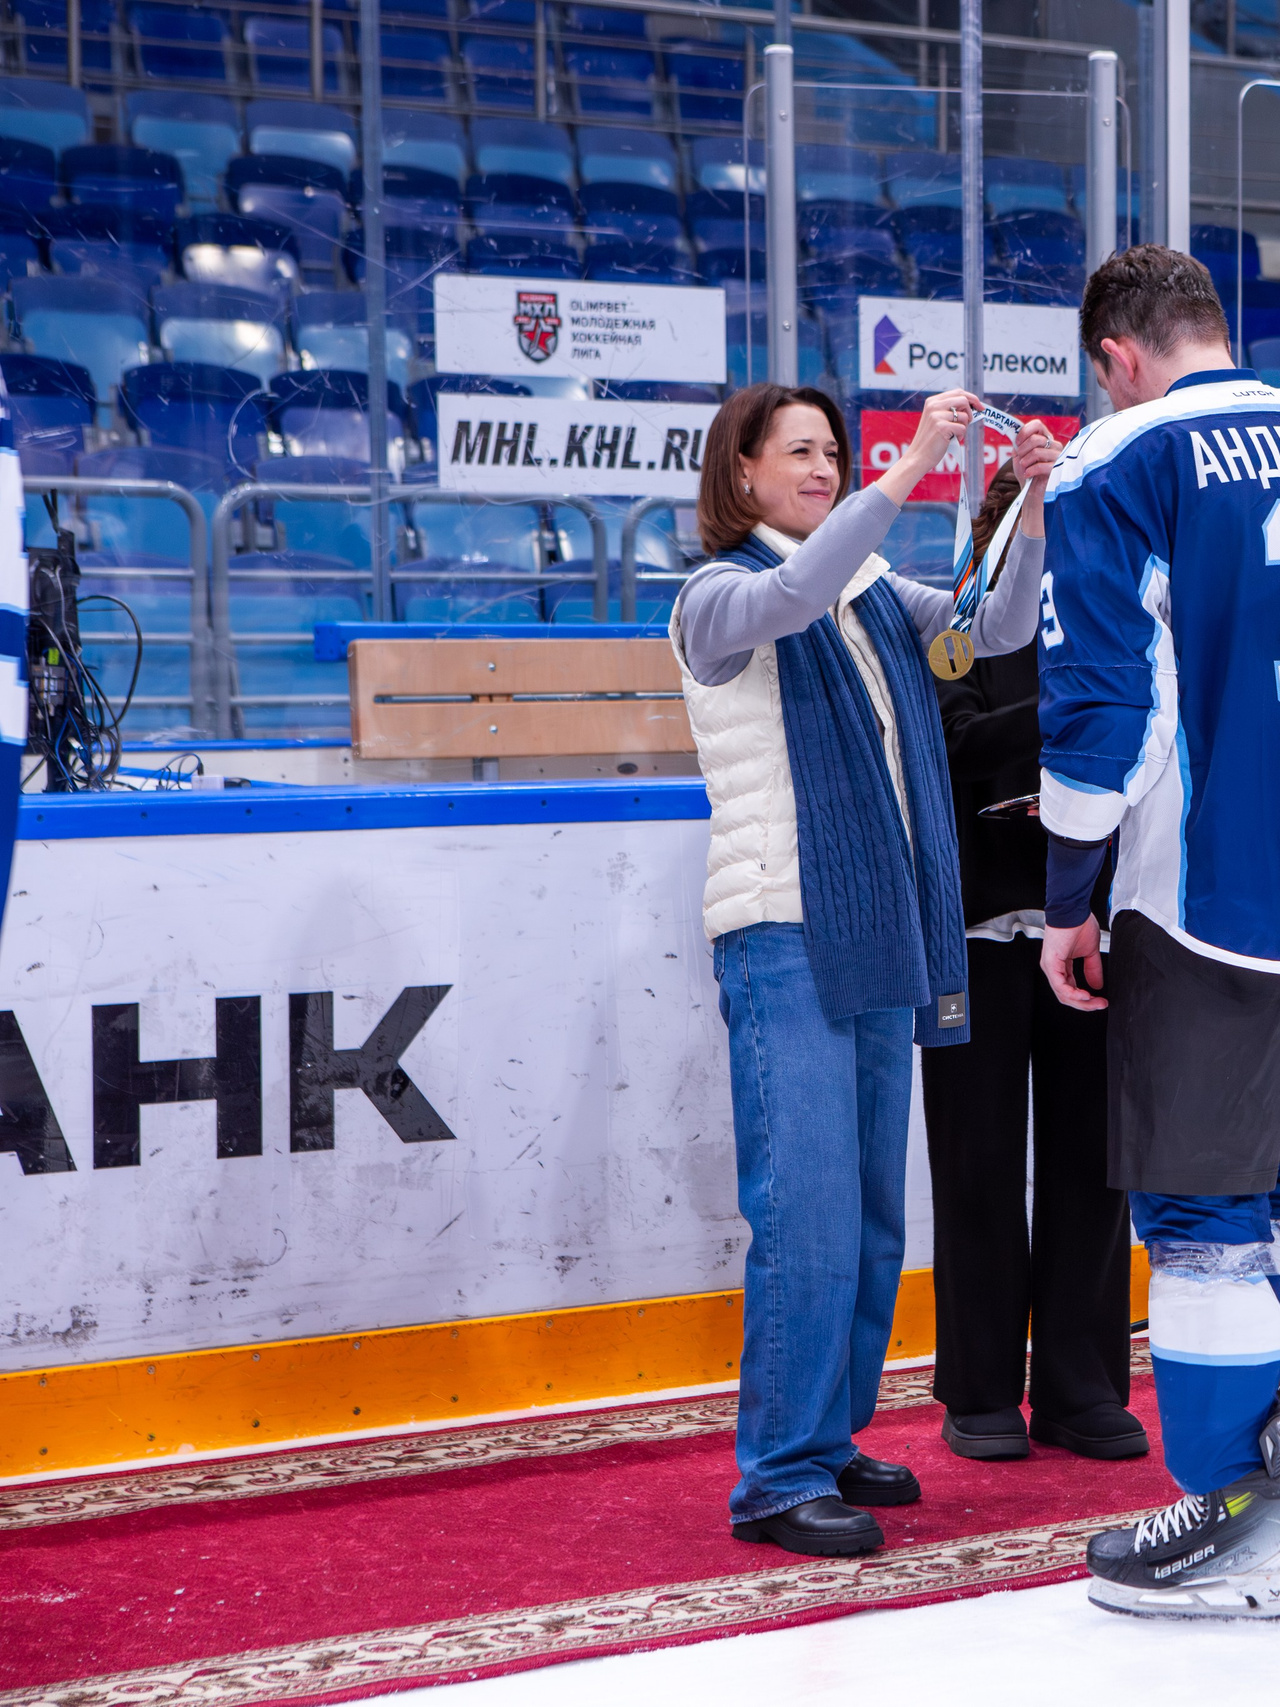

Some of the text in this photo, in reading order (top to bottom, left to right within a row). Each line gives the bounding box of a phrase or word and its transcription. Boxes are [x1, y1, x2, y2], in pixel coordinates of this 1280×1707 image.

[570, 301, 628, 313] OLIMPBET
[571, 316, 657, 331] МОЛОДЕЖНАЯ
[571, 330, 642, 346] ХОККЕЙНАЯ
[571, 348, 602, 361] ЛИГА
[1232, 390, 1275, 398] LUTCH
[1040, 570, 1065, 652] 3
[1160, 1544, 1215, 1579] BAUER
